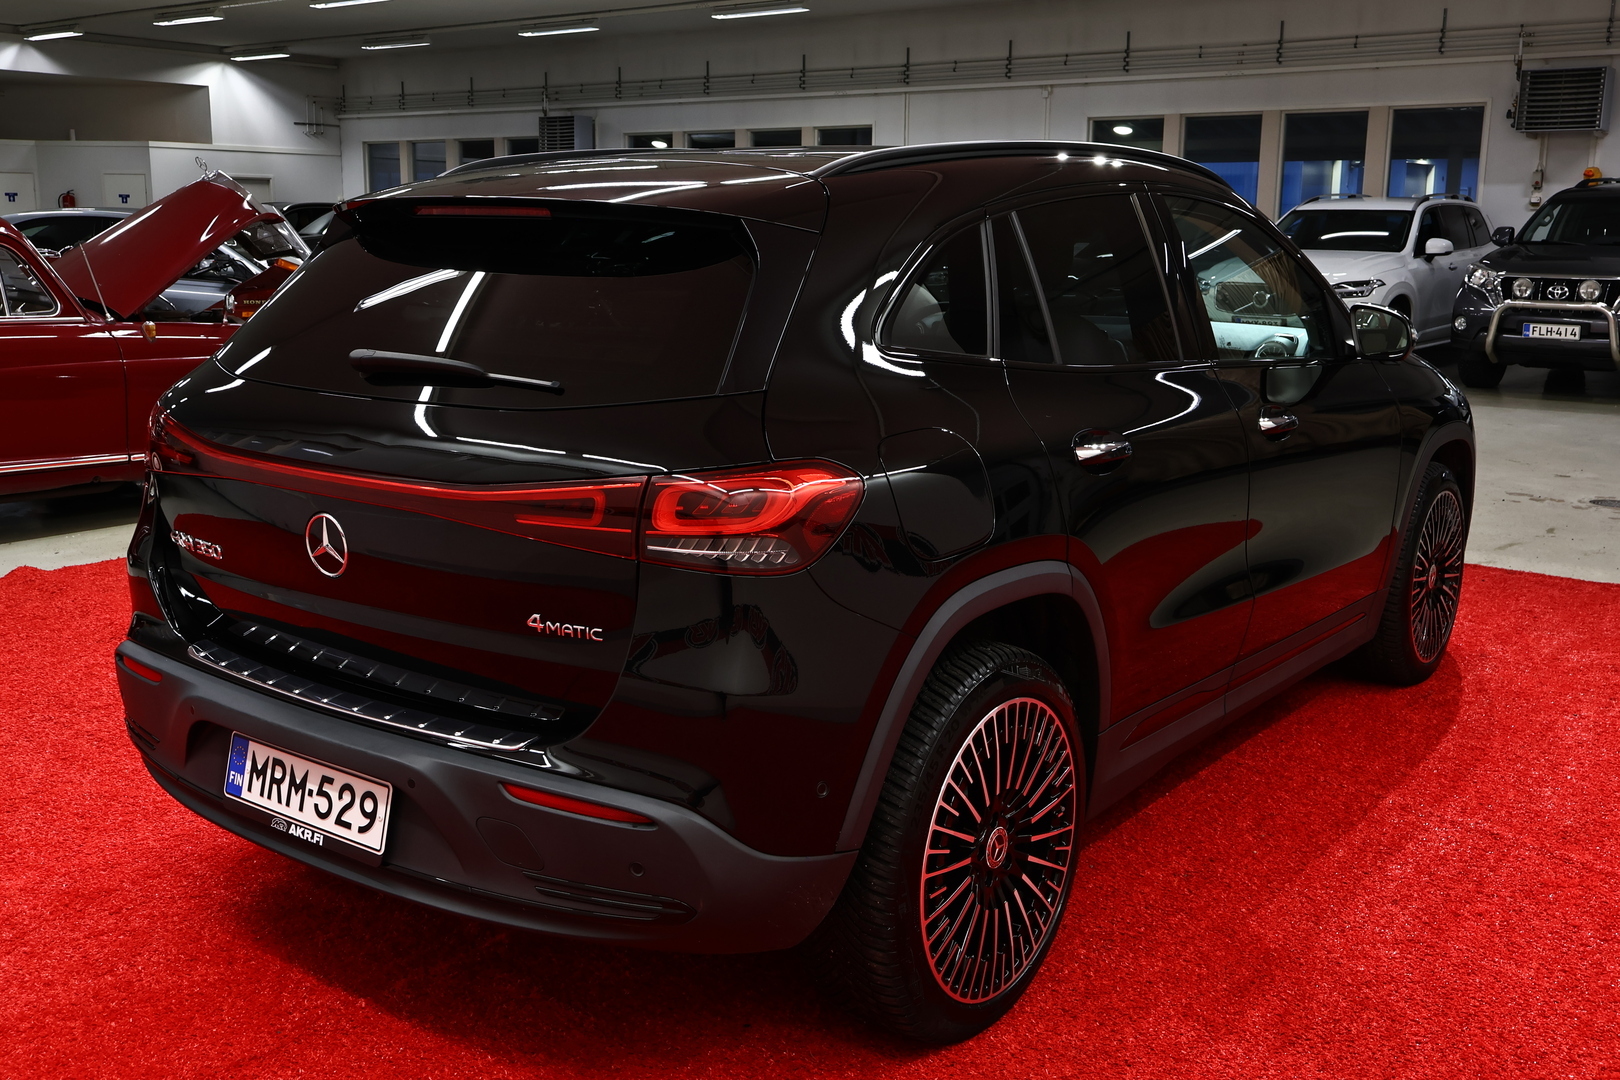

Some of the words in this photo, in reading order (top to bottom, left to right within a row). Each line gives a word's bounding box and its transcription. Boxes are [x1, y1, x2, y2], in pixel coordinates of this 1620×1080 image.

[1531, 326, 1577, 338] FLH-414
[195, 538, 223, 560] 350
[526, 613, 604, 642] 4MATIC
[228, 771, 243, 787] FIN
[247, 750, 379, 834] MRM-529
[288, 824, 324, 846] AKR.FI
